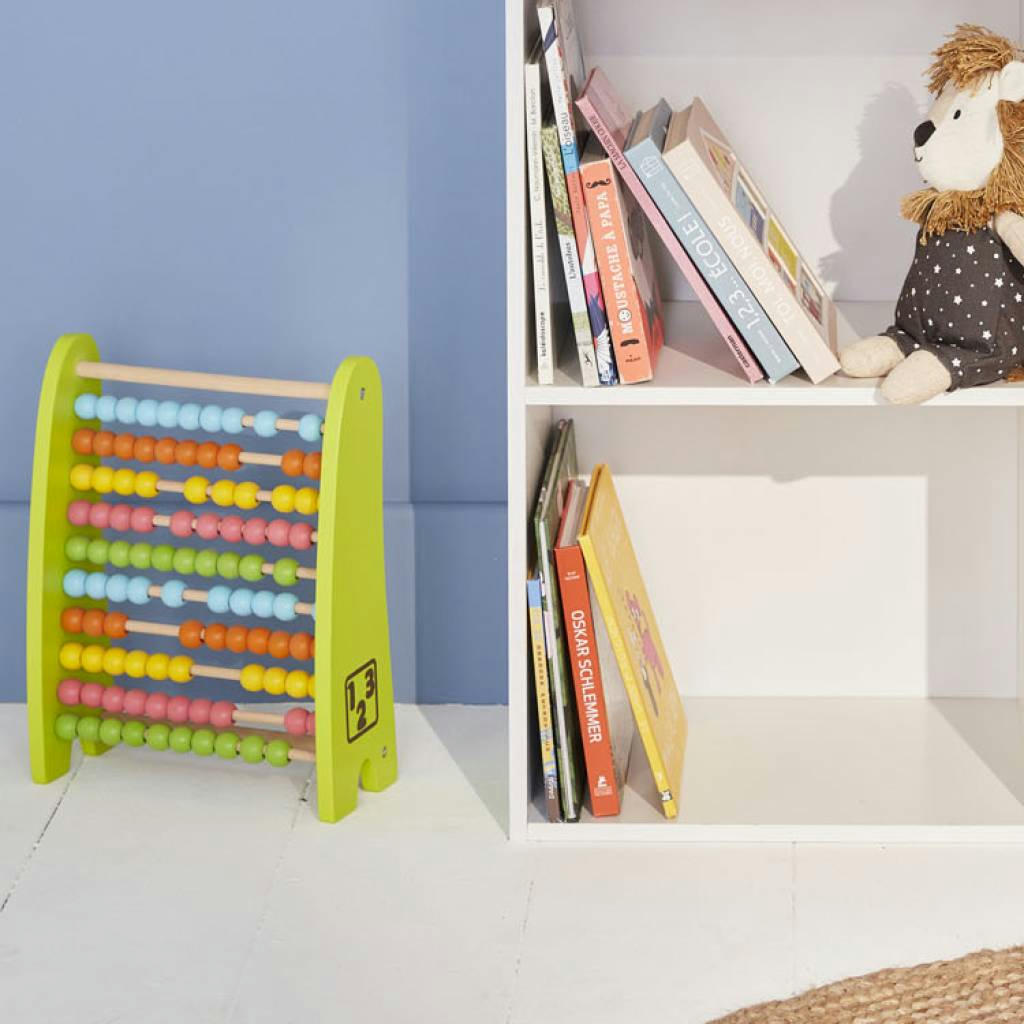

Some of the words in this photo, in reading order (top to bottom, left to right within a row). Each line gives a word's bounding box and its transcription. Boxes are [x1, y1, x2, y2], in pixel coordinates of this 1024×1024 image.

[597, 190, 612, 227] PAPA
[570, 609, 591, 657] OSKAR
[578, 658, 603, 744] SCHLEMMER
